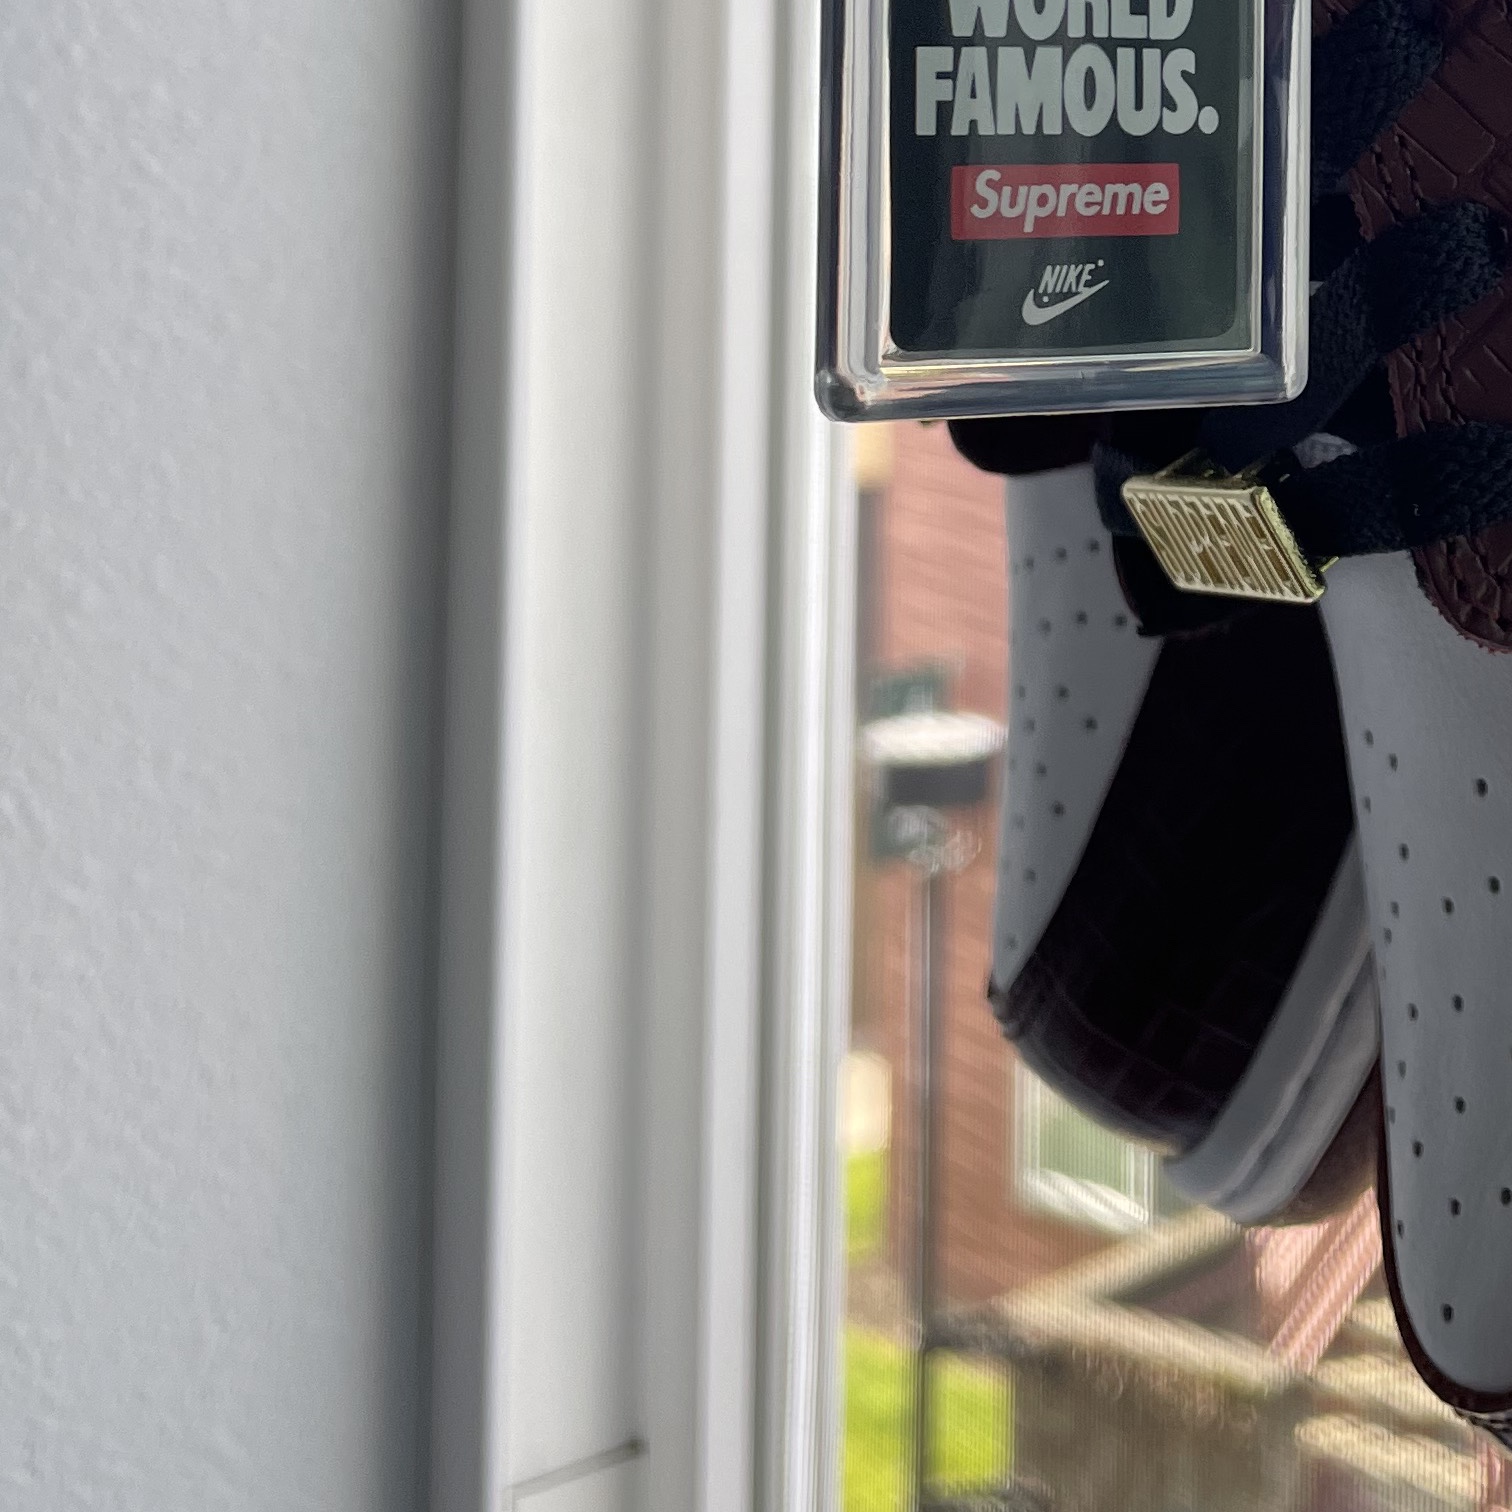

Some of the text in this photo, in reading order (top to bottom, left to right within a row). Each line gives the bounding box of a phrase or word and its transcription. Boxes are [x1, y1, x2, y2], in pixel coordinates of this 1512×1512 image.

[915, 44, 1219, 136] FAMOUS.
[970, 169, 1170, 233] Supreme
[1038, 263, 1097, 294] NIKE
